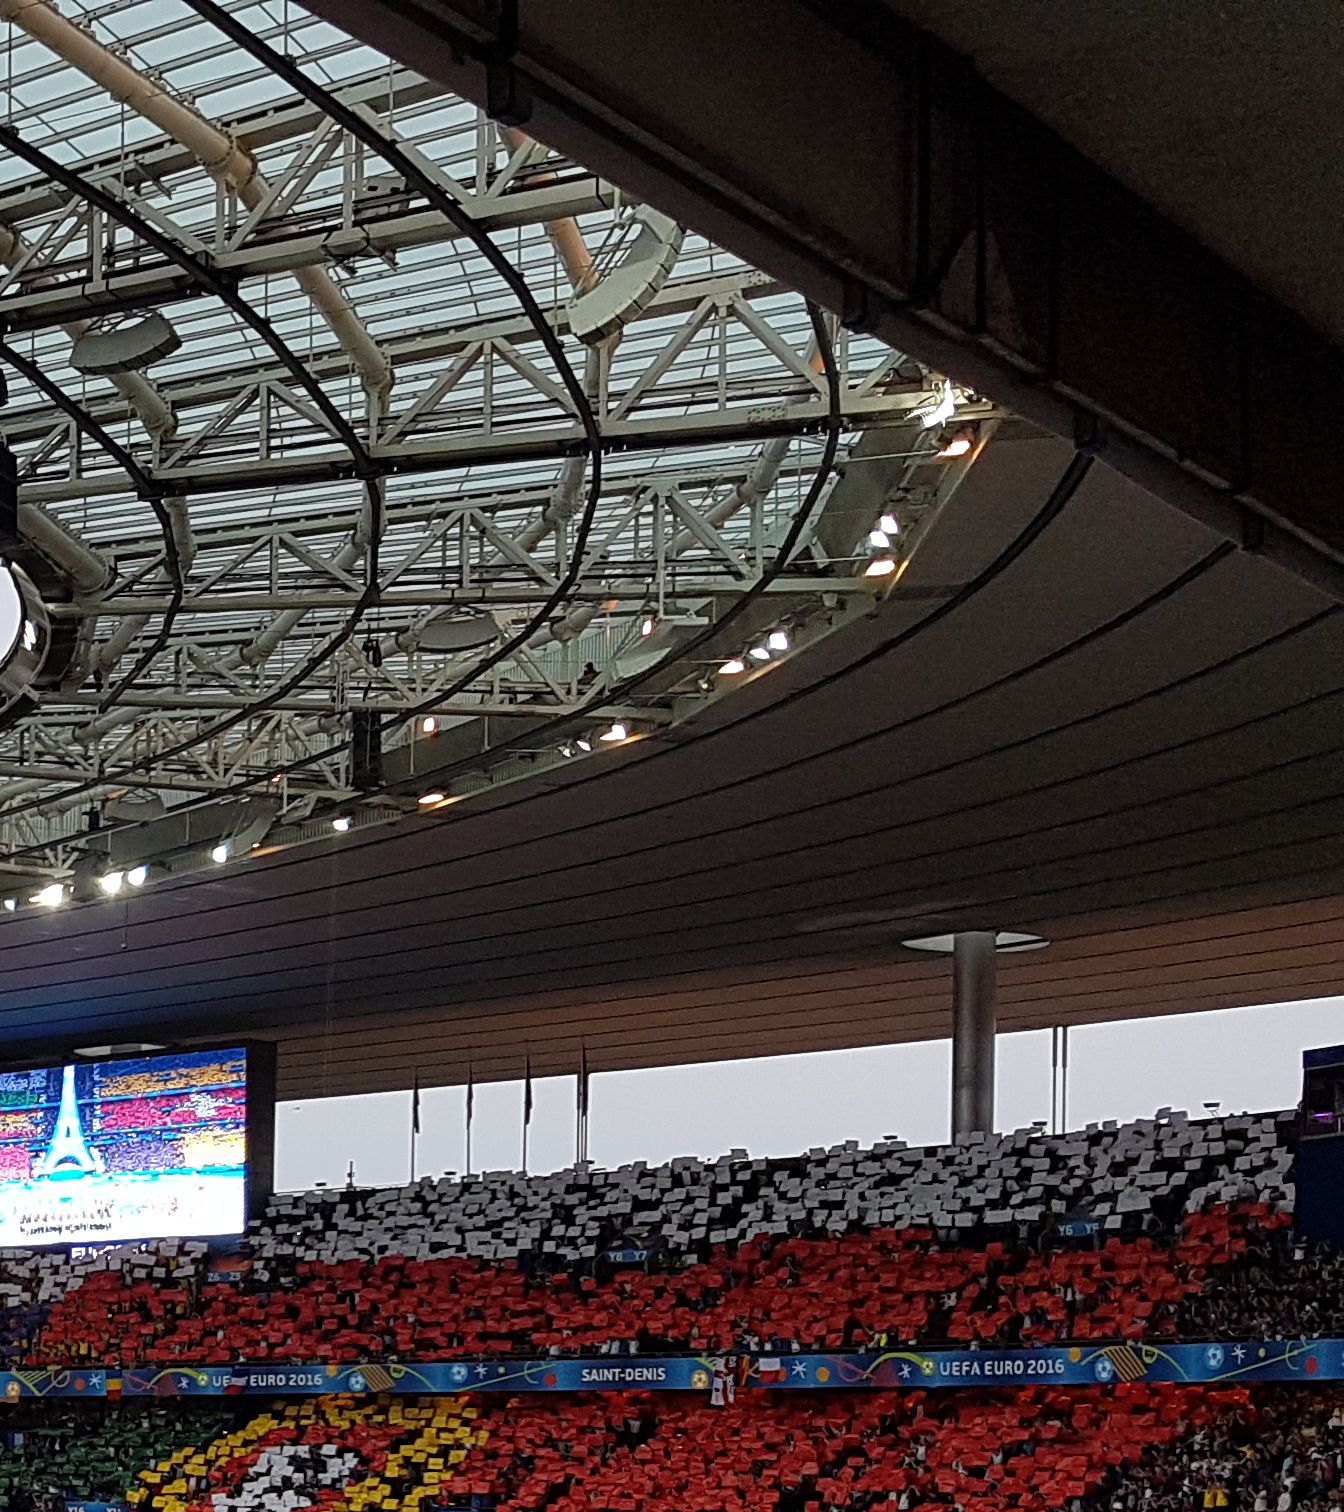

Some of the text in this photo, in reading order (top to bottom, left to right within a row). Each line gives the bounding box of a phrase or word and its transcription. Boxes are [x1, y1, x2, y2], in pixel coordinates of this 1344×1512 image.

[581, 1367, 666, 1382] SAINT-DENIS
[940, 1358, 1064, 1376] UEFA EURO 2016
[250, 1374, 287, 1387] EURO
[288, 1373, 323, 1386] 2016
